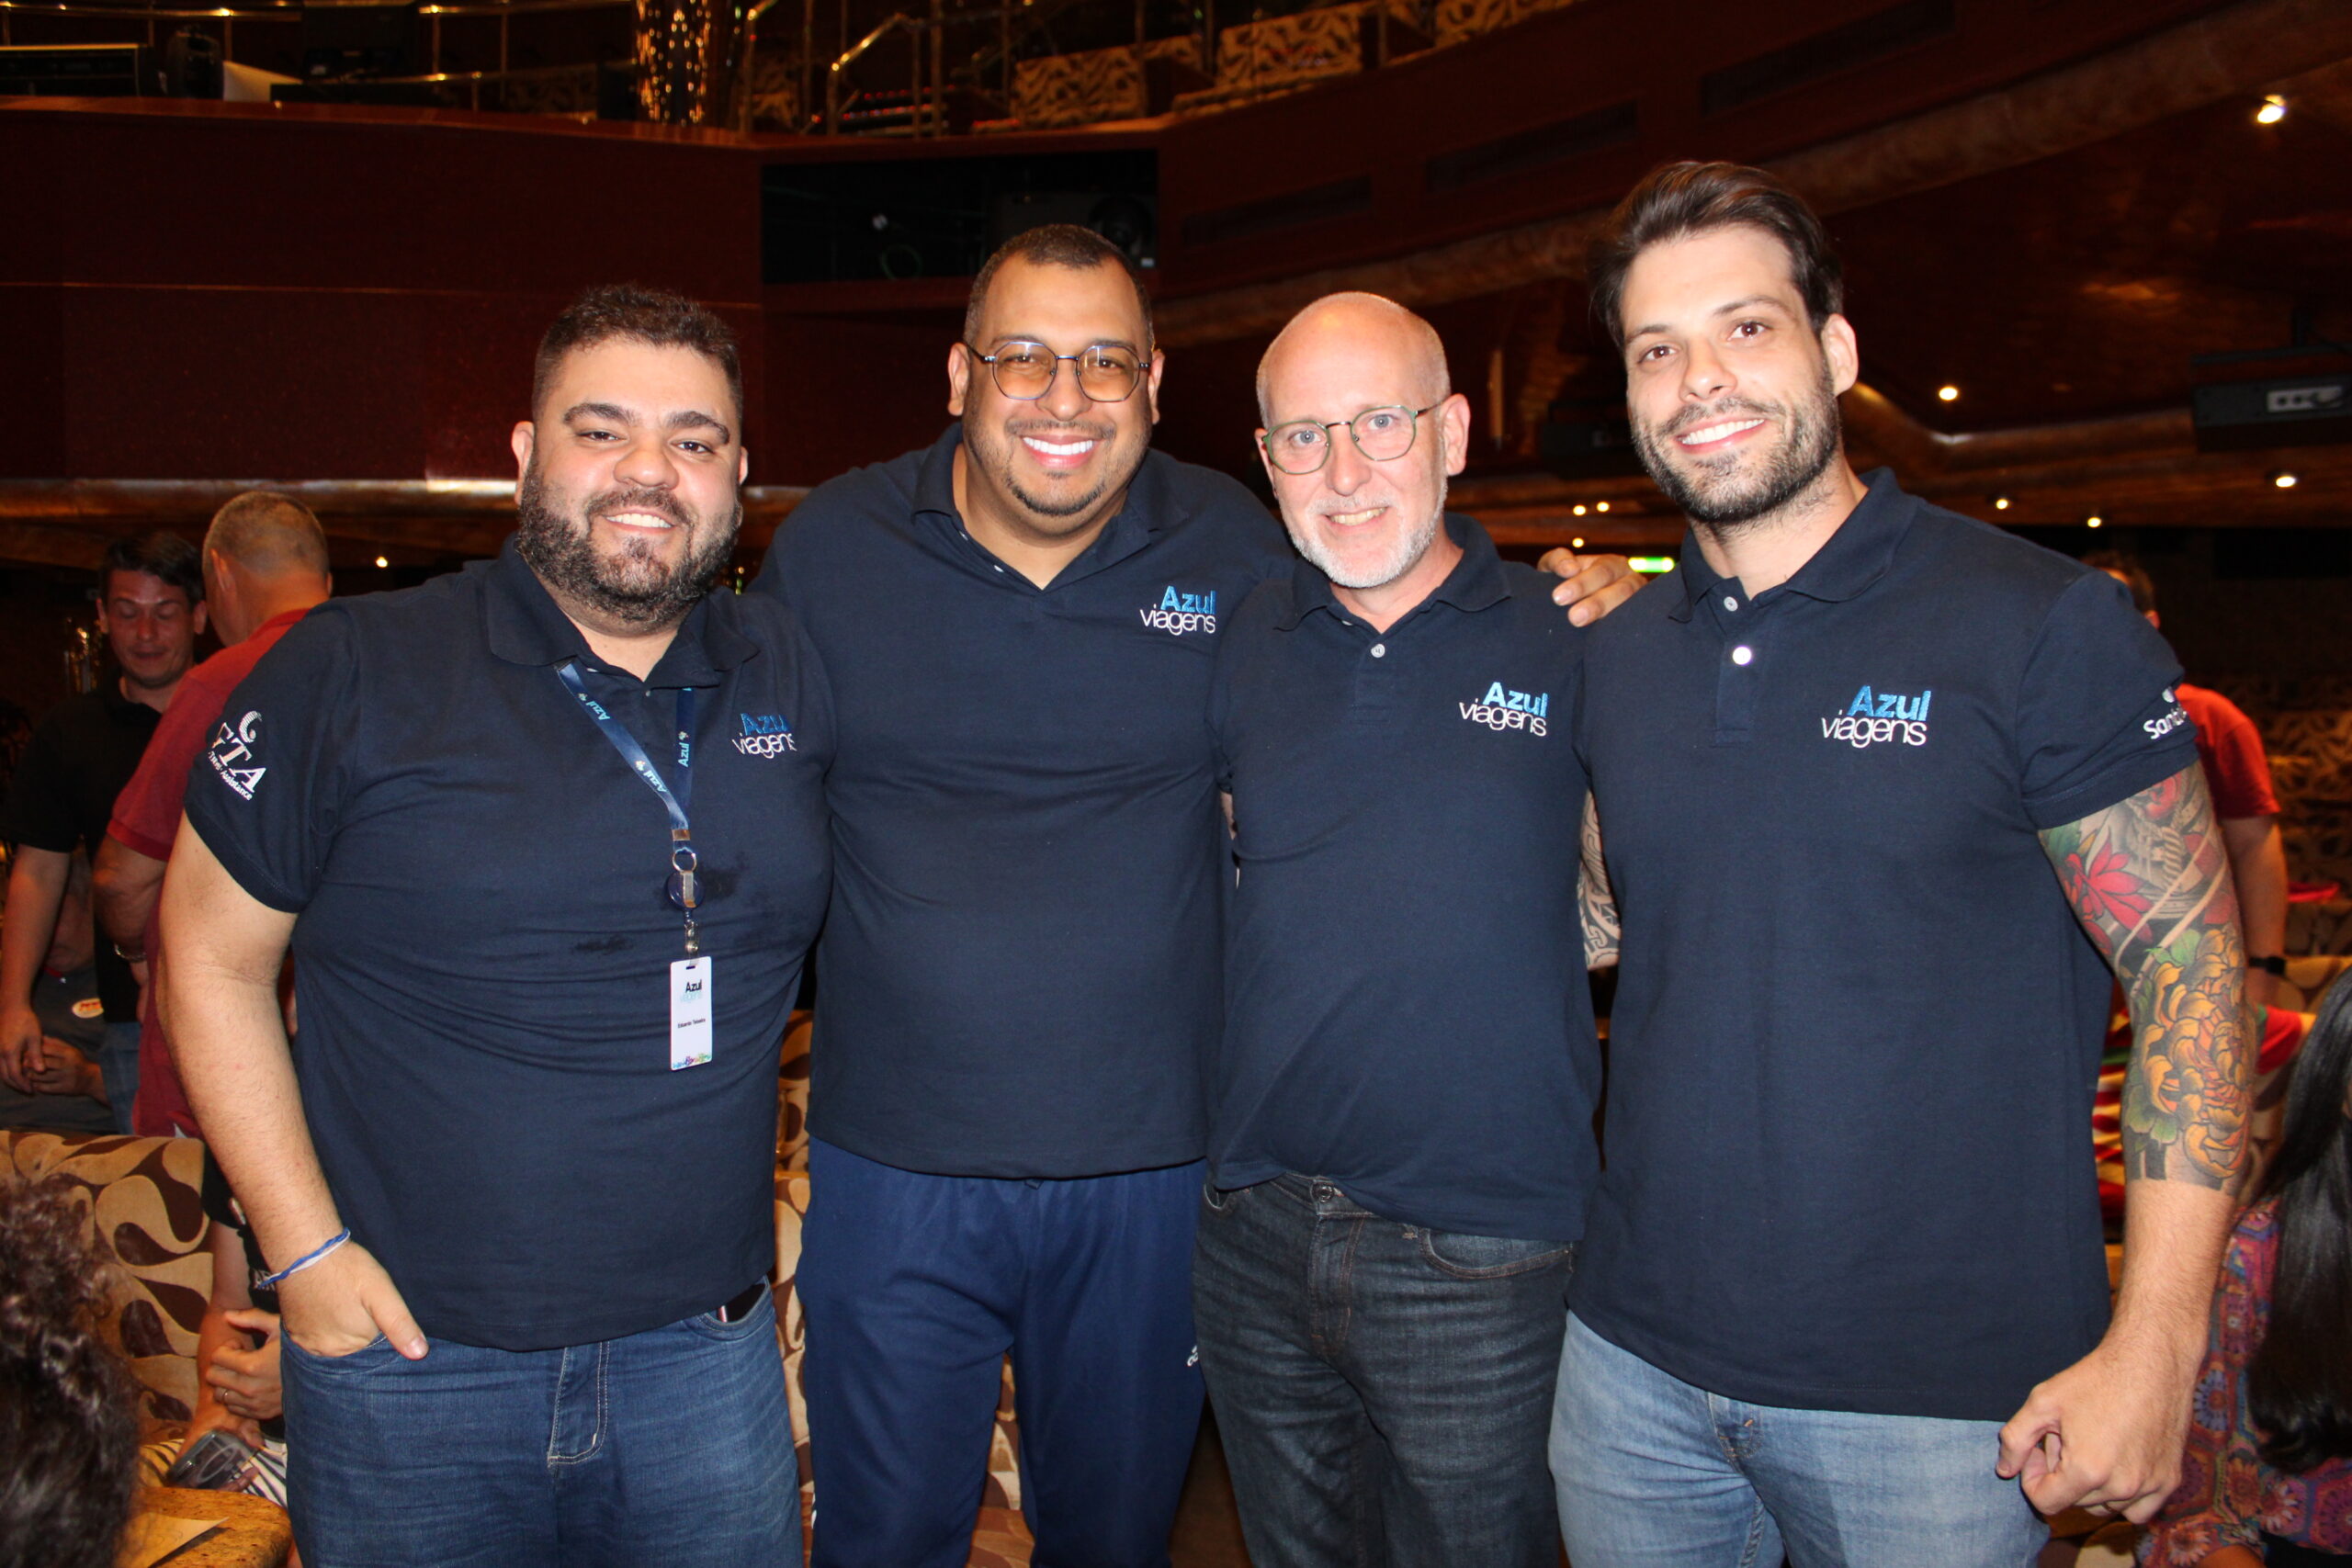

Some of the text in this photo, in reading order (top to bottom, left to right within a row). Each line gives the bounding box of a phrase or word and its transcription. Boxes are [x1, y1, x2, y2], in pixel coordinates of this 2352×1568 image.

[1160, 585, 1216, 615] Azul
[1139, 604, 1216, 636] viagens
[586, 700, 611, 720] Azul
[1482, 682, 1548, 717] Azul
[1847, 684, 1931, 721] Azul
[1458, 698, 1547, 737] viagens
[1821, 709, 1928, 749] viagens
[678, 742, 690, 768] Azul
[643, 770, 667, 792] Azul
[685, 978, 702, 993] Azul
